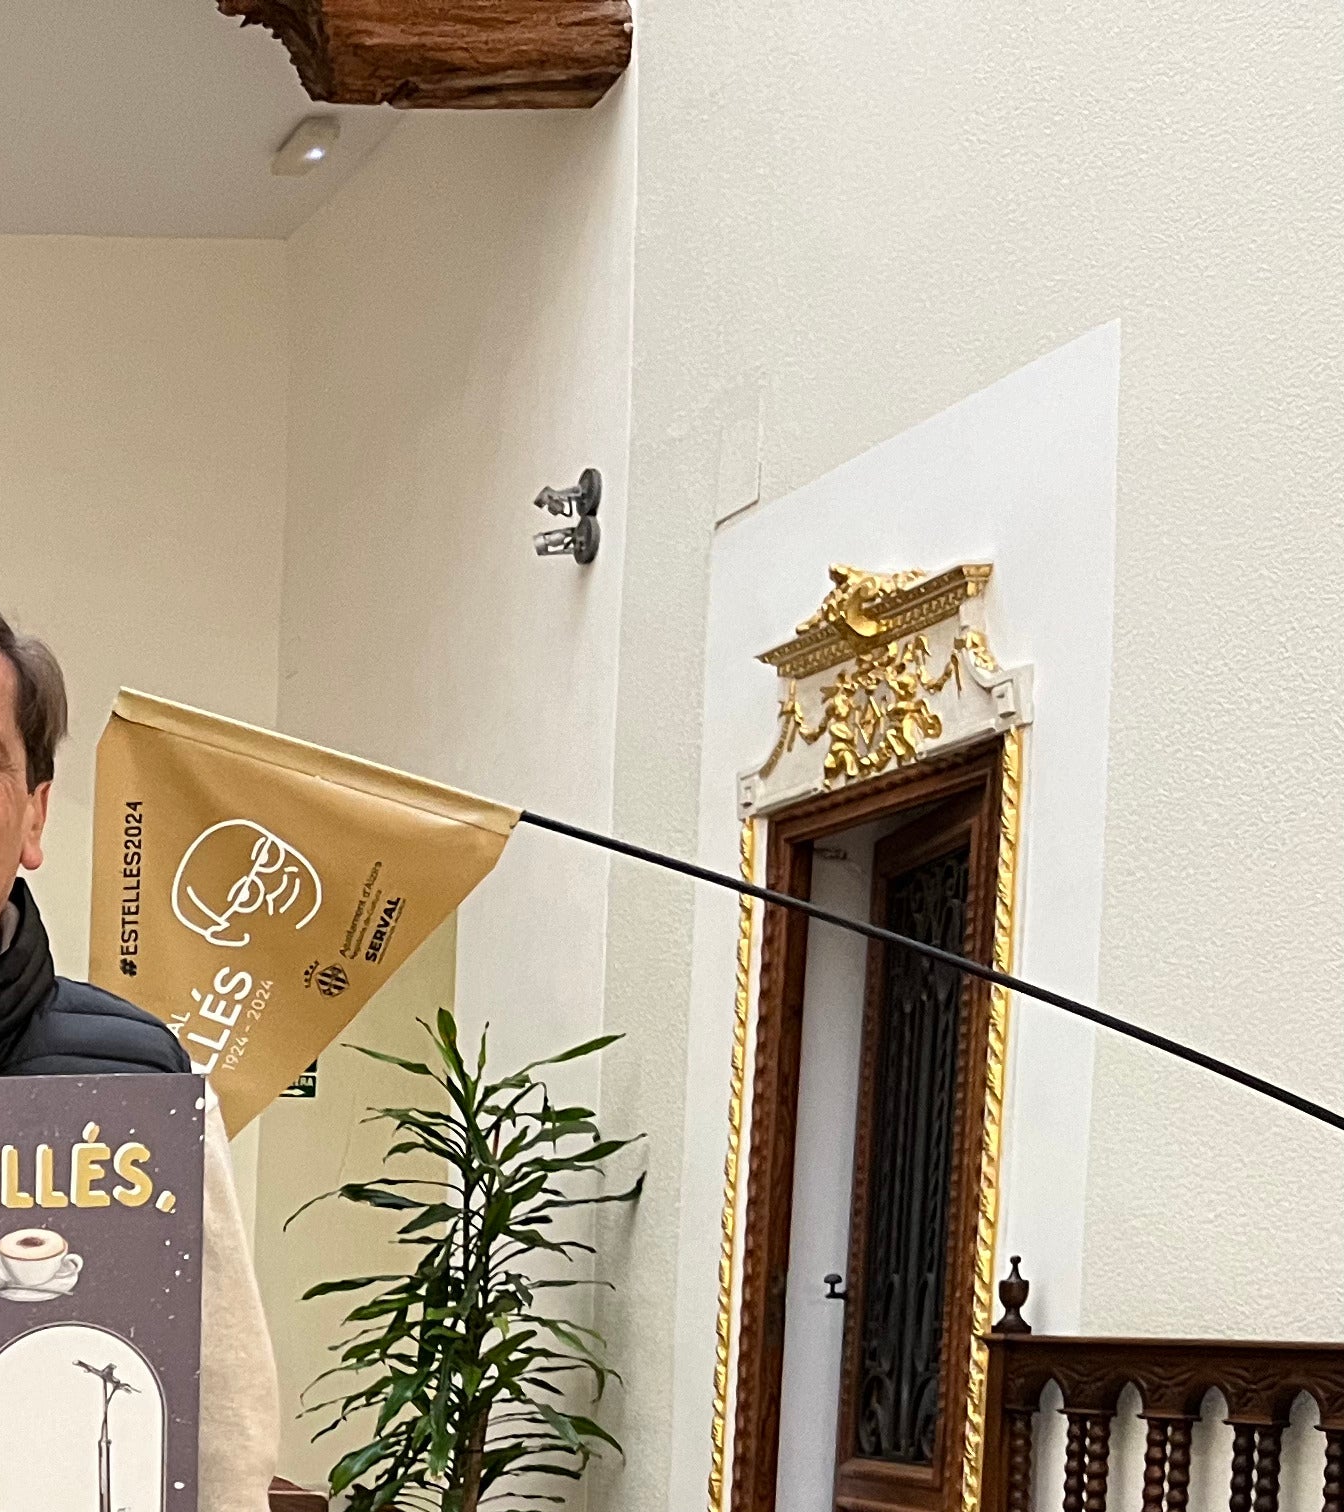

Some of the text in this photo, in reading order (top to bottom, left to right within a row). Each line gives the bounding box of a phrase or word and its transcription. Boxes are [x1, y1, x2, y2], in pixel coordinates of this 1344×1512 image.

[119, 801, 143, 977] #ESTELLÉS2024
[365, 897, 401, 962] SERVAL
[222, 1037, 248, 1070] 1924
[247, 980, 273, 1020] 2024
